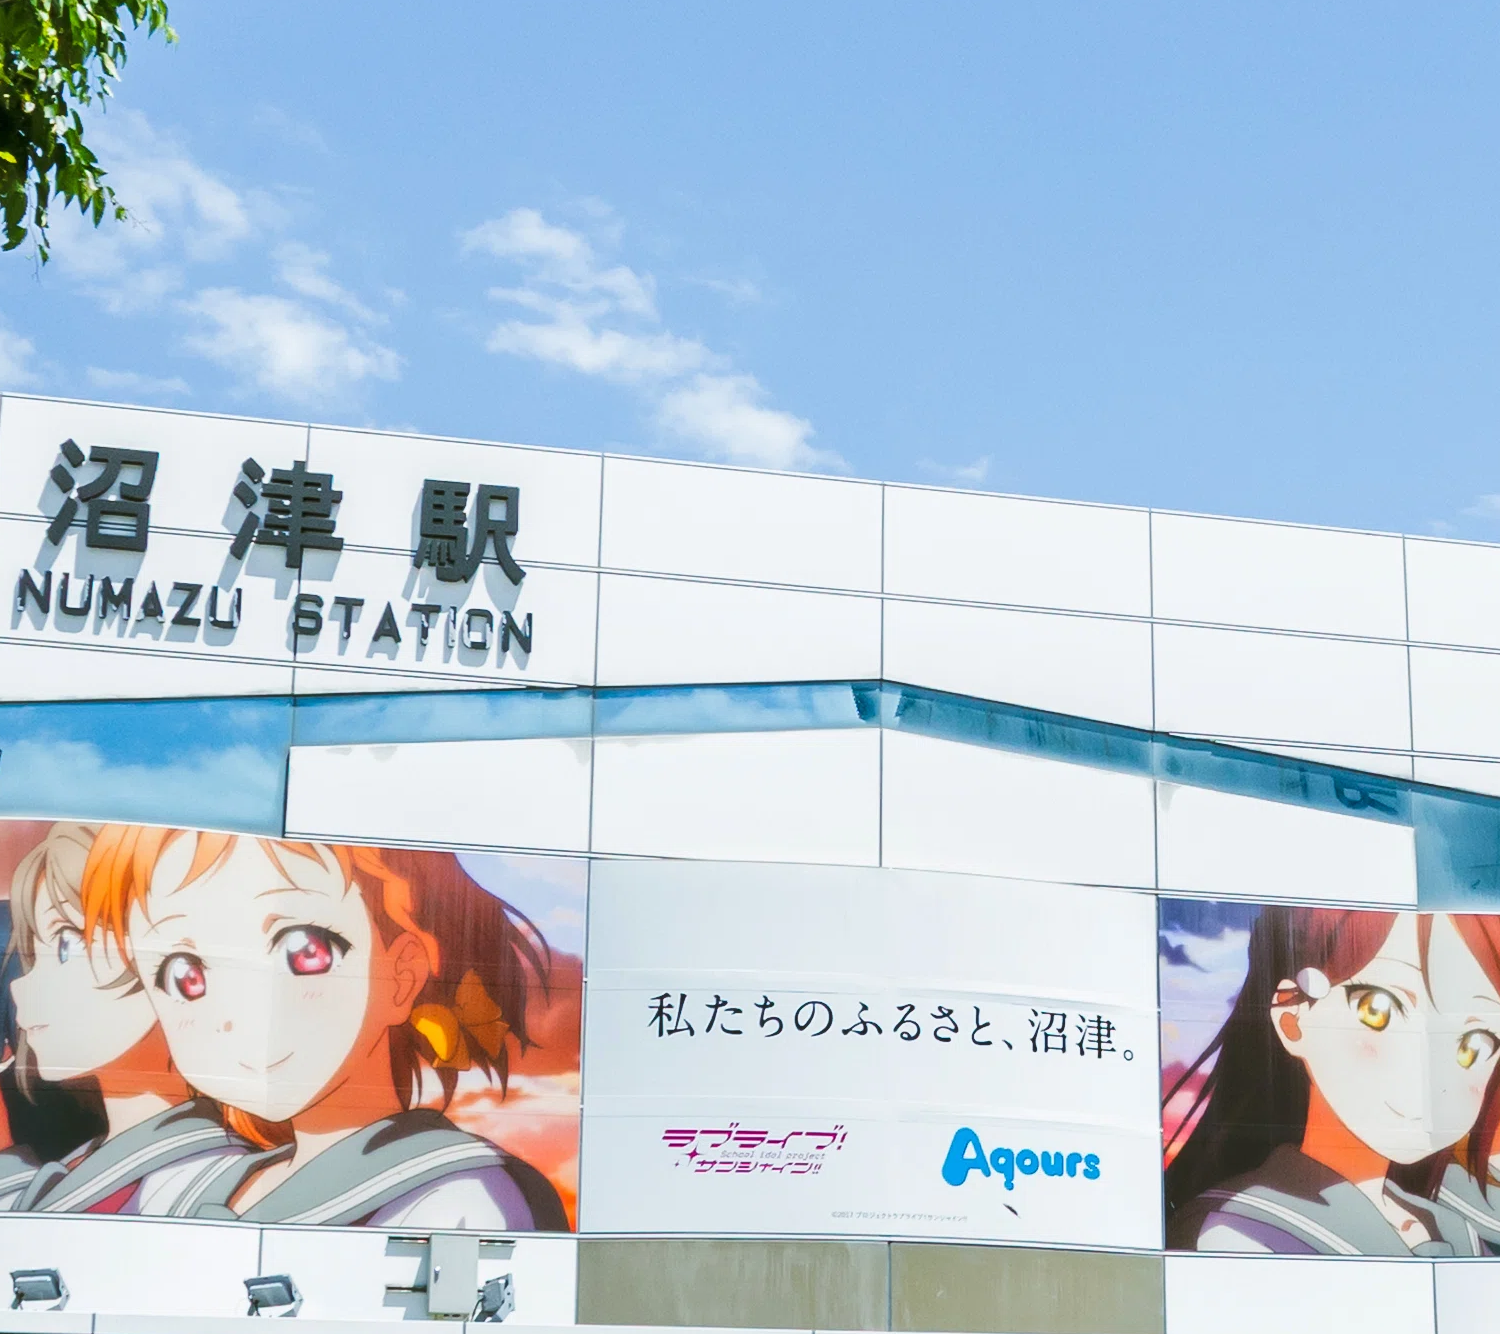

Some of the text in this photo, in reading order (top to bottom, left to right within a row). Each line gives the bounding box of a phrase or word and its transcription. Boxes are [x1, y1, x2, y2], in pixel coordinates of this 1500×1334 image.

[45, 437, 527, 586] 沼津駅
[17, 567, 533, 656] NUMAZU STATION
[647, 992, 1135, 1062] 私たちのふるさと、沼津。
[662, 1122, 848, 1151] ラブライブ!
[694, 1160, 823, 1175] サンシャイン!!
[942, 1127, 1100, 1190] Aqours
